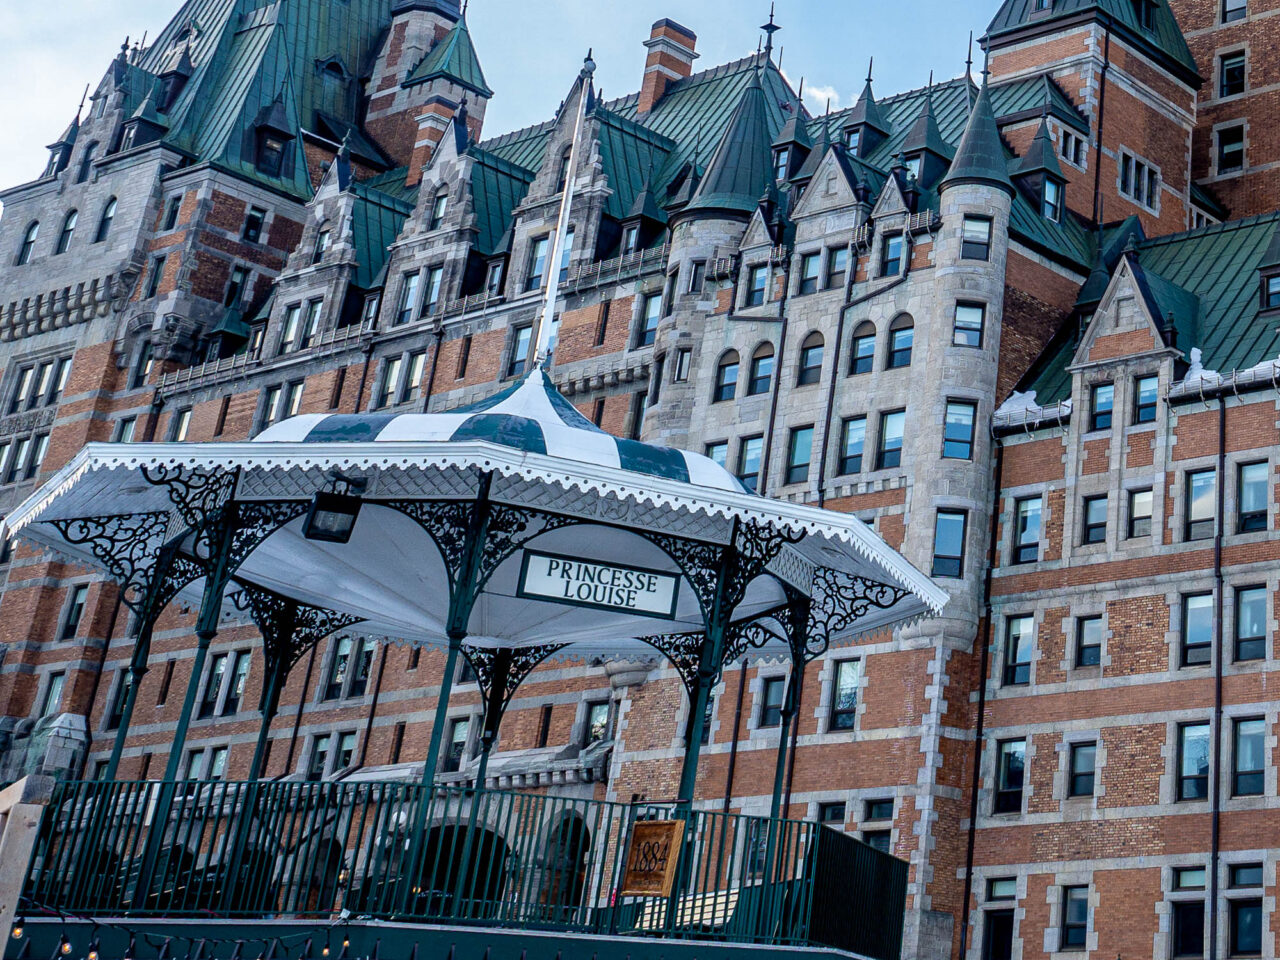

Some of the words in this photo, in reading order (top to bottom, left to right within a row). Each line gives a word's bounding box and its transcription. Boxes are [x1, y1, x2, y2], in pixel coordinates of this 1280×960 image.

[547, 559, 658, 593] PRINCESSE
[564, 580, 638, 608] LOUISE
[632, 841, 669, 872] 1884
